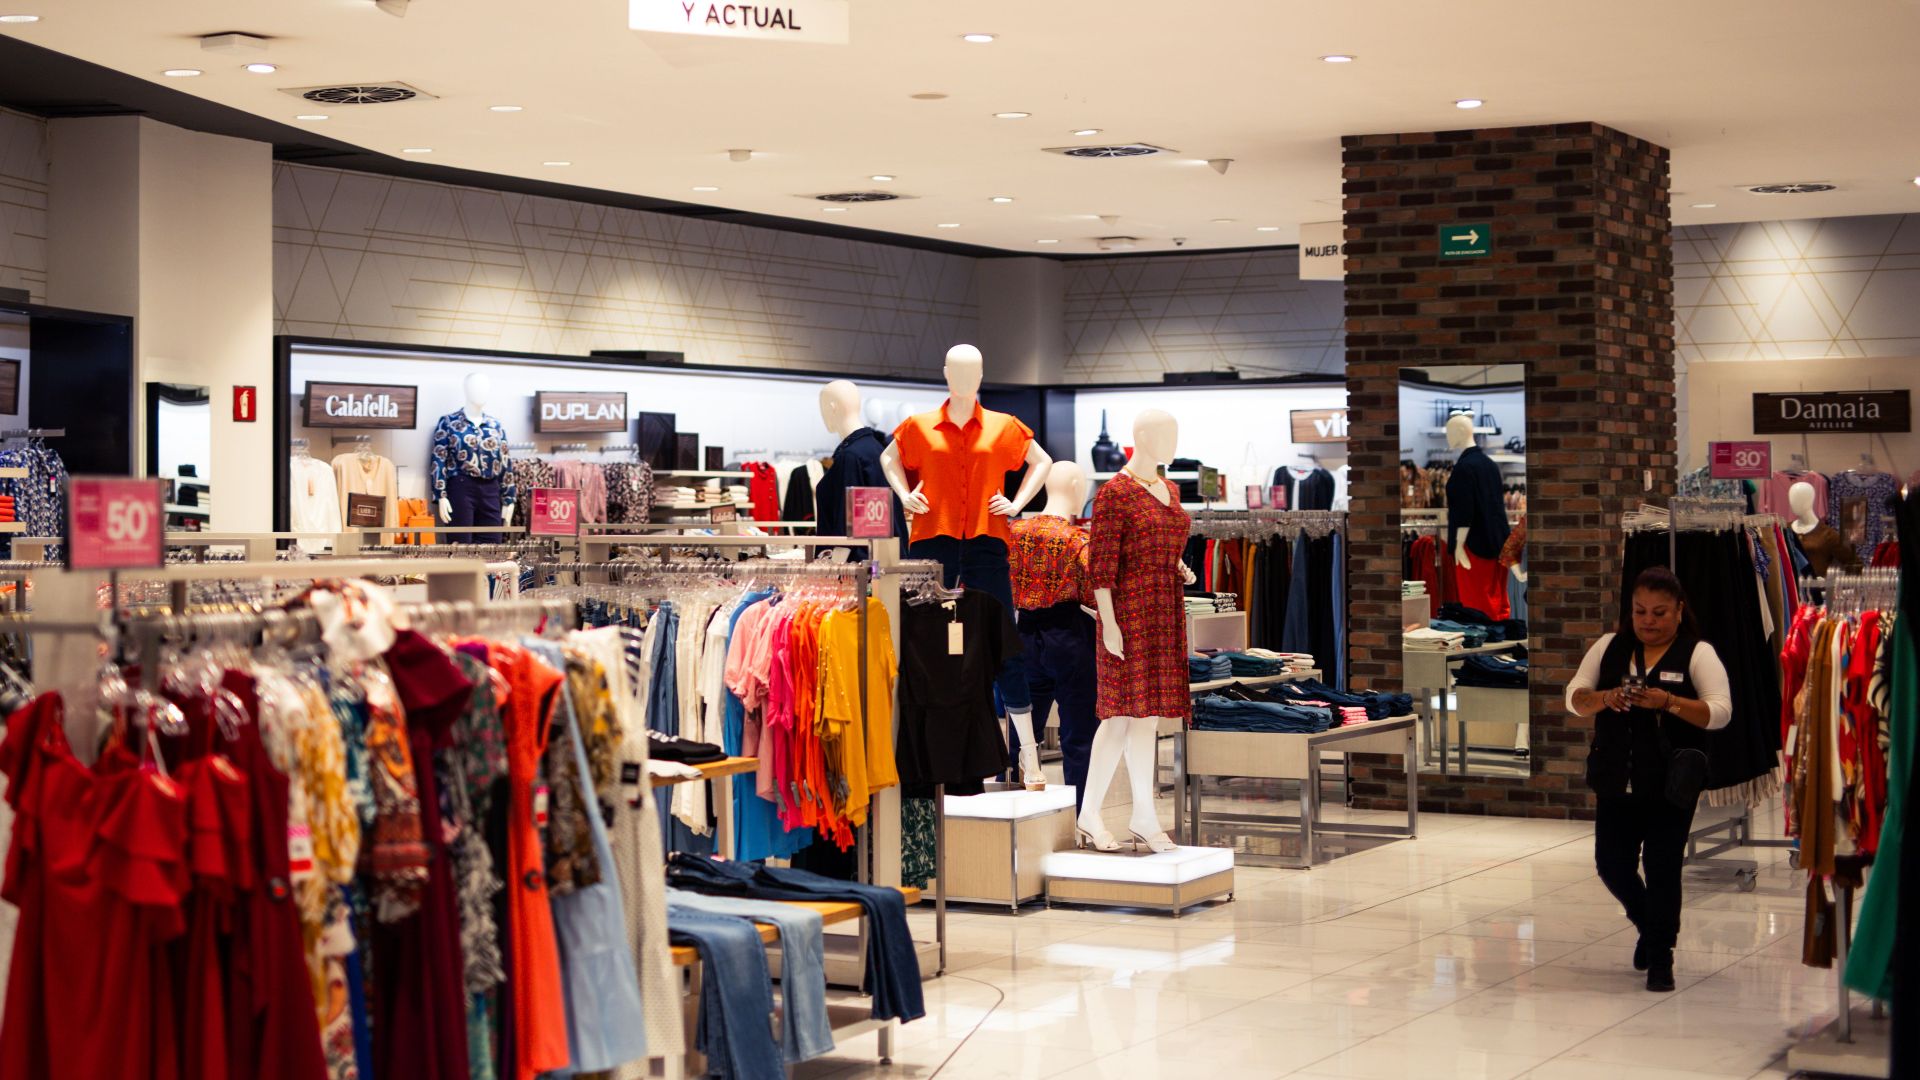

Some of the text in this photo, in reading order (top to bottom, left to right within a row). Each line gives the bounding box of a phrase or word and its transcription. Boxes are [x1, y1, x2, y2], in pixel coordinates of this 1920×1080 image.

[682, 1, 802, 30] Y ACTUAL
[1305, 244, 1339, 257] MUJER
[325, 393, 399, 418] Calafella
[541, 402, 625, 421] DUPLAN
[1780, 397, 1881, 420] Damaia
[1808, 421, 1854, 429] ATELIER
